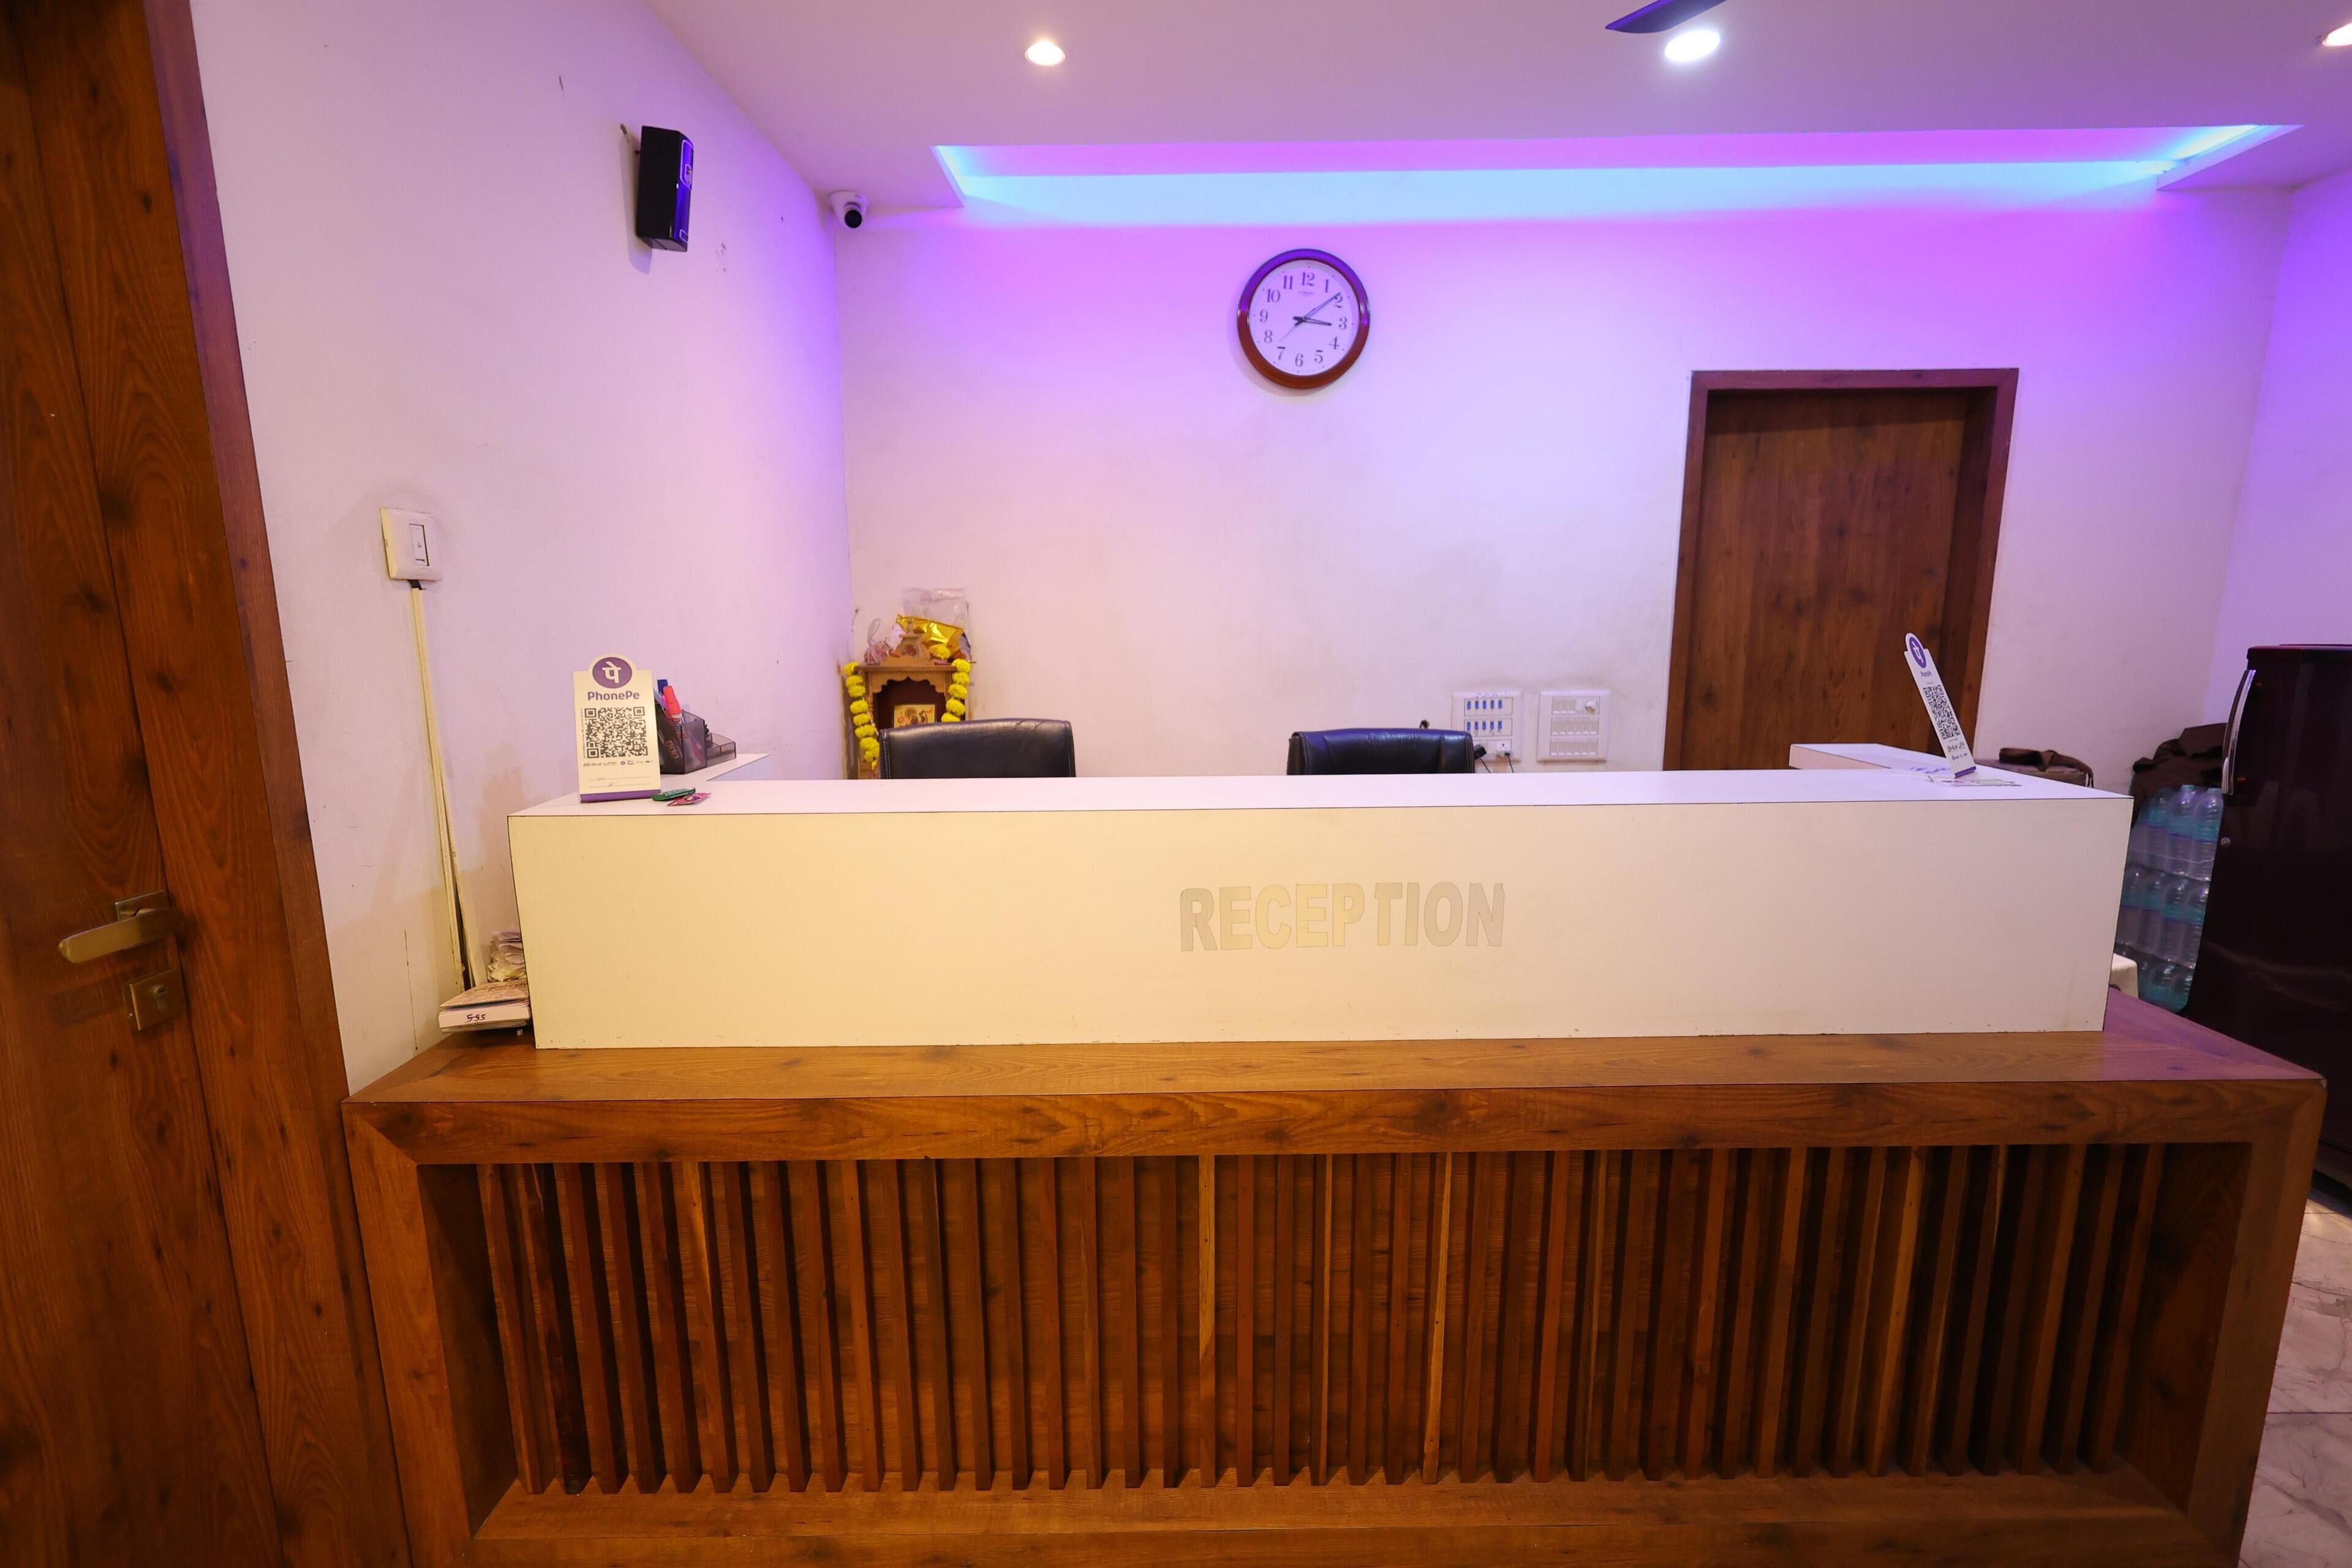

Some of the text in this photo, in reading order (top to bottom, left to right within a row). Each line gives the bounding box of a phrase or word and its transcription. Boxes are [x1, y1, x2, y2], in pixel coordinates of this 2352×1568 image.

[1283, 275, 1293, 290] 11
[1302, 272, 1315, 286] 12
[1325, 279, 1329, 293] 1
[1266, 288, 1280, 303] 10
[1333, 293, 1343, 308] 2
[1259, 309, 1268, 323] 9
[1338, 317, 1348, 330] 3
[1264, 330, 1273, 344] 8
[1329, 337, 1340, 349] 4
[1276, 346, 1286, 360] 7
[1295, 353, 1303, 367] 6
[1314, 350, 1323, 363] 5
[587, 691, 640, 701] PhonePe
[1180, 882, 1505, 952] RECEPTION
